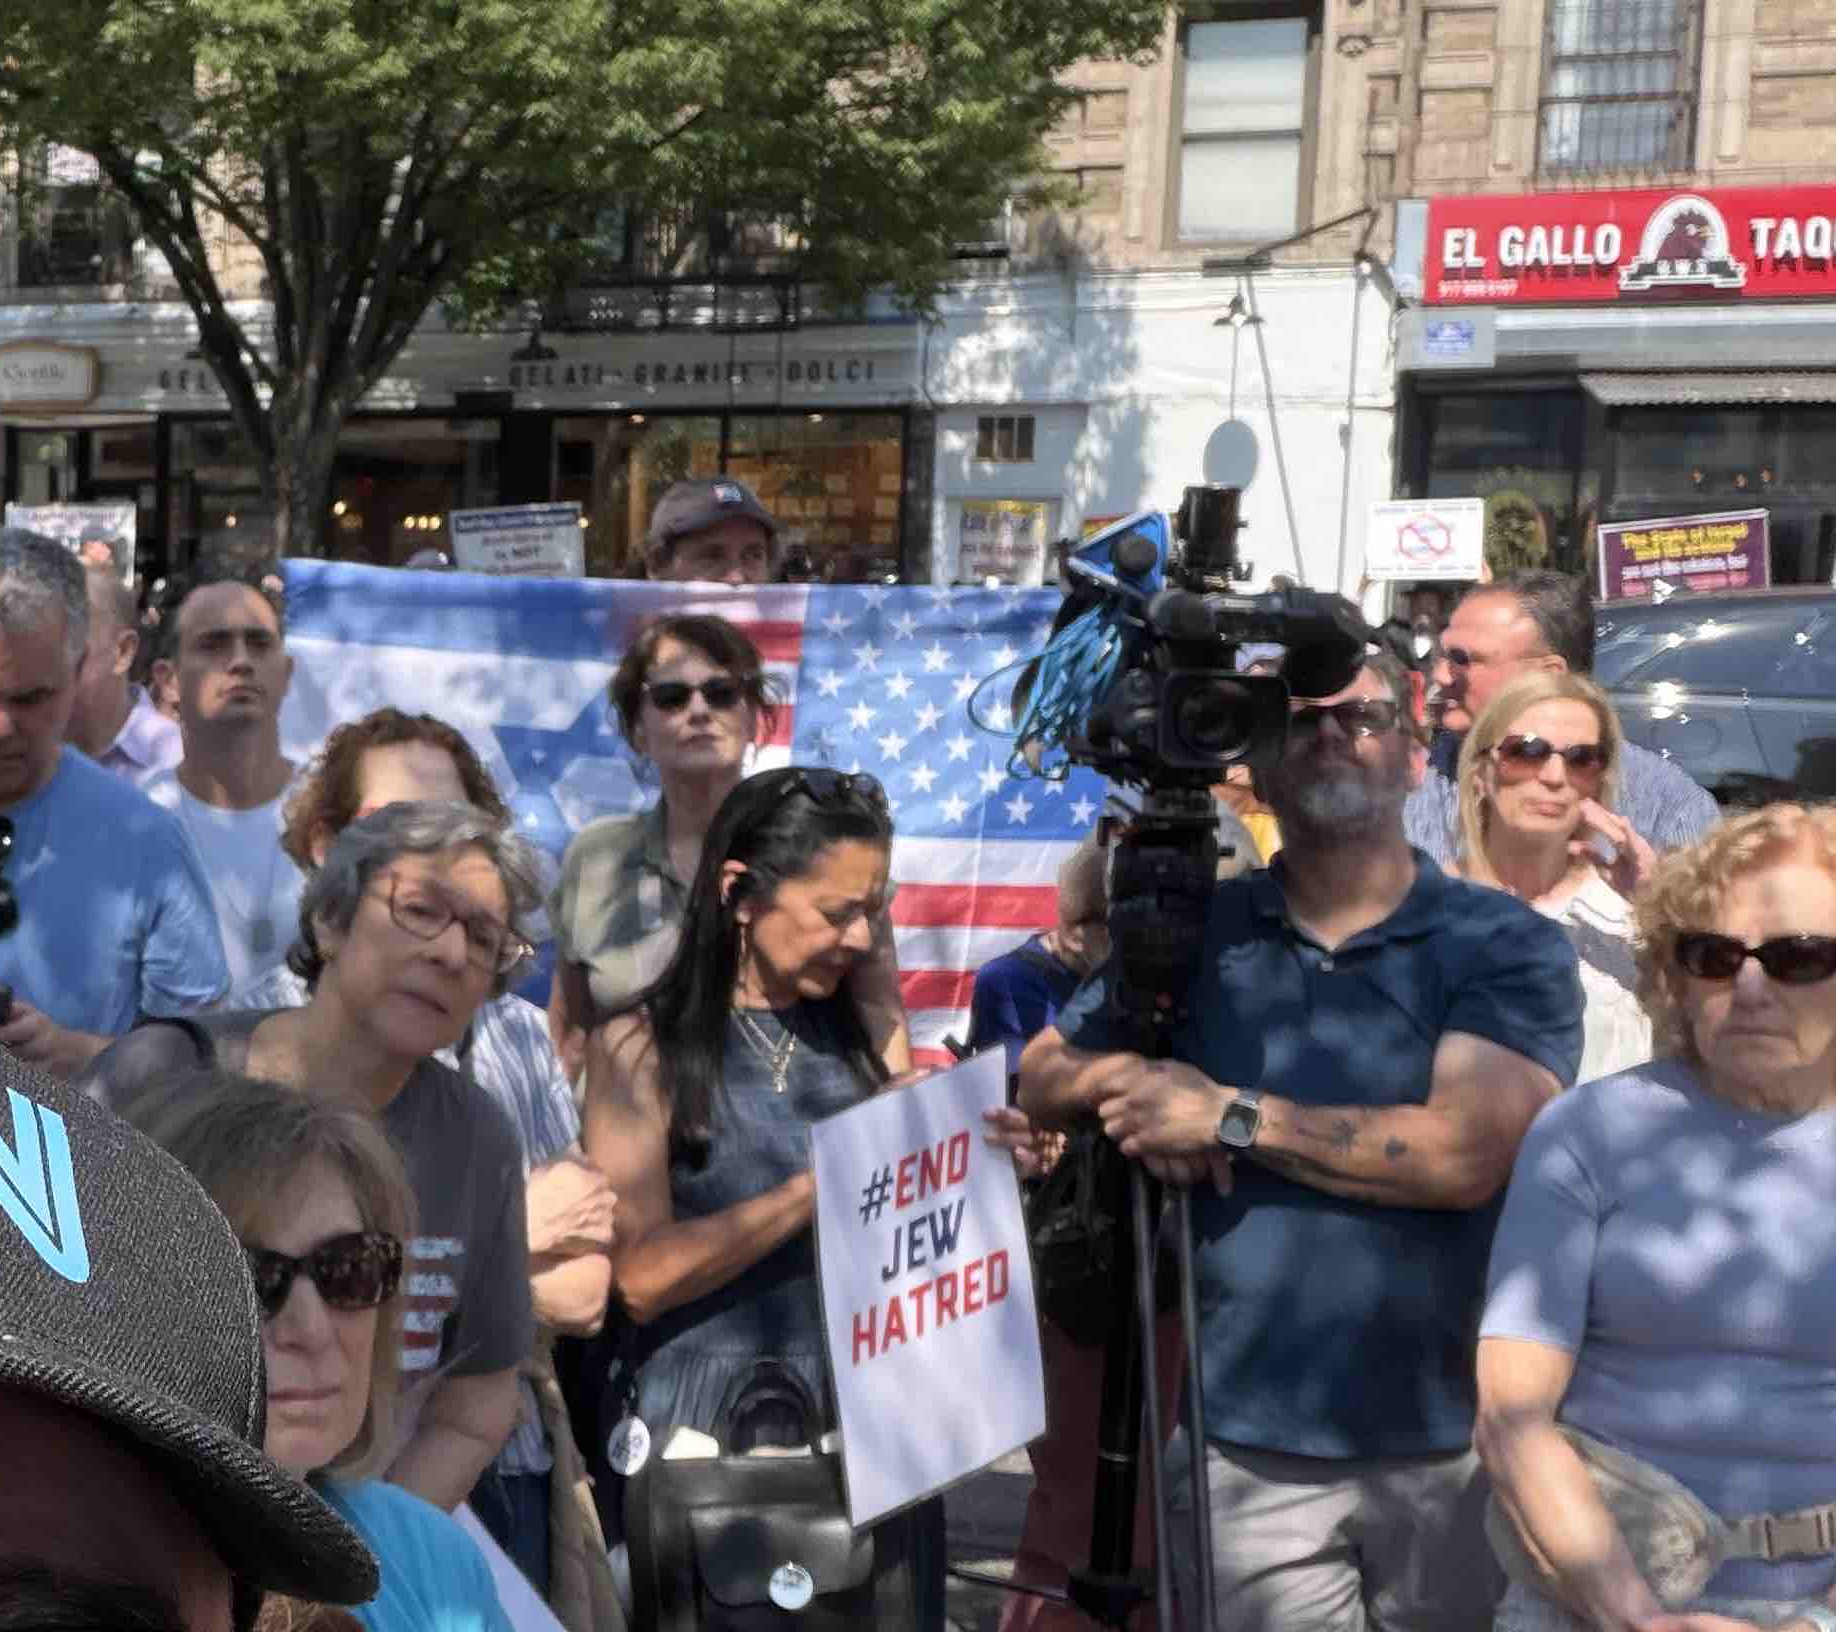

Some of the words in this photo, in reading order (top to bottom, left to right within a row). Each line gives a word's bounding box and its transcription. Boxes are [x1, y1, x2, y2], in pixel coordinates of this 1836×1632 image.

[1443, 227, 1486, 267] EL
[1499, 223, 1622, 267] GALLO
[1750, 216, 1836, 260] TAQ
[786, 359, 875, 383] DOLCI
[859, 1127, 971, 1227] #END
[881, 1196, 966, 1282] JEW
[850, 1248, 1010, 1367] HATRED
